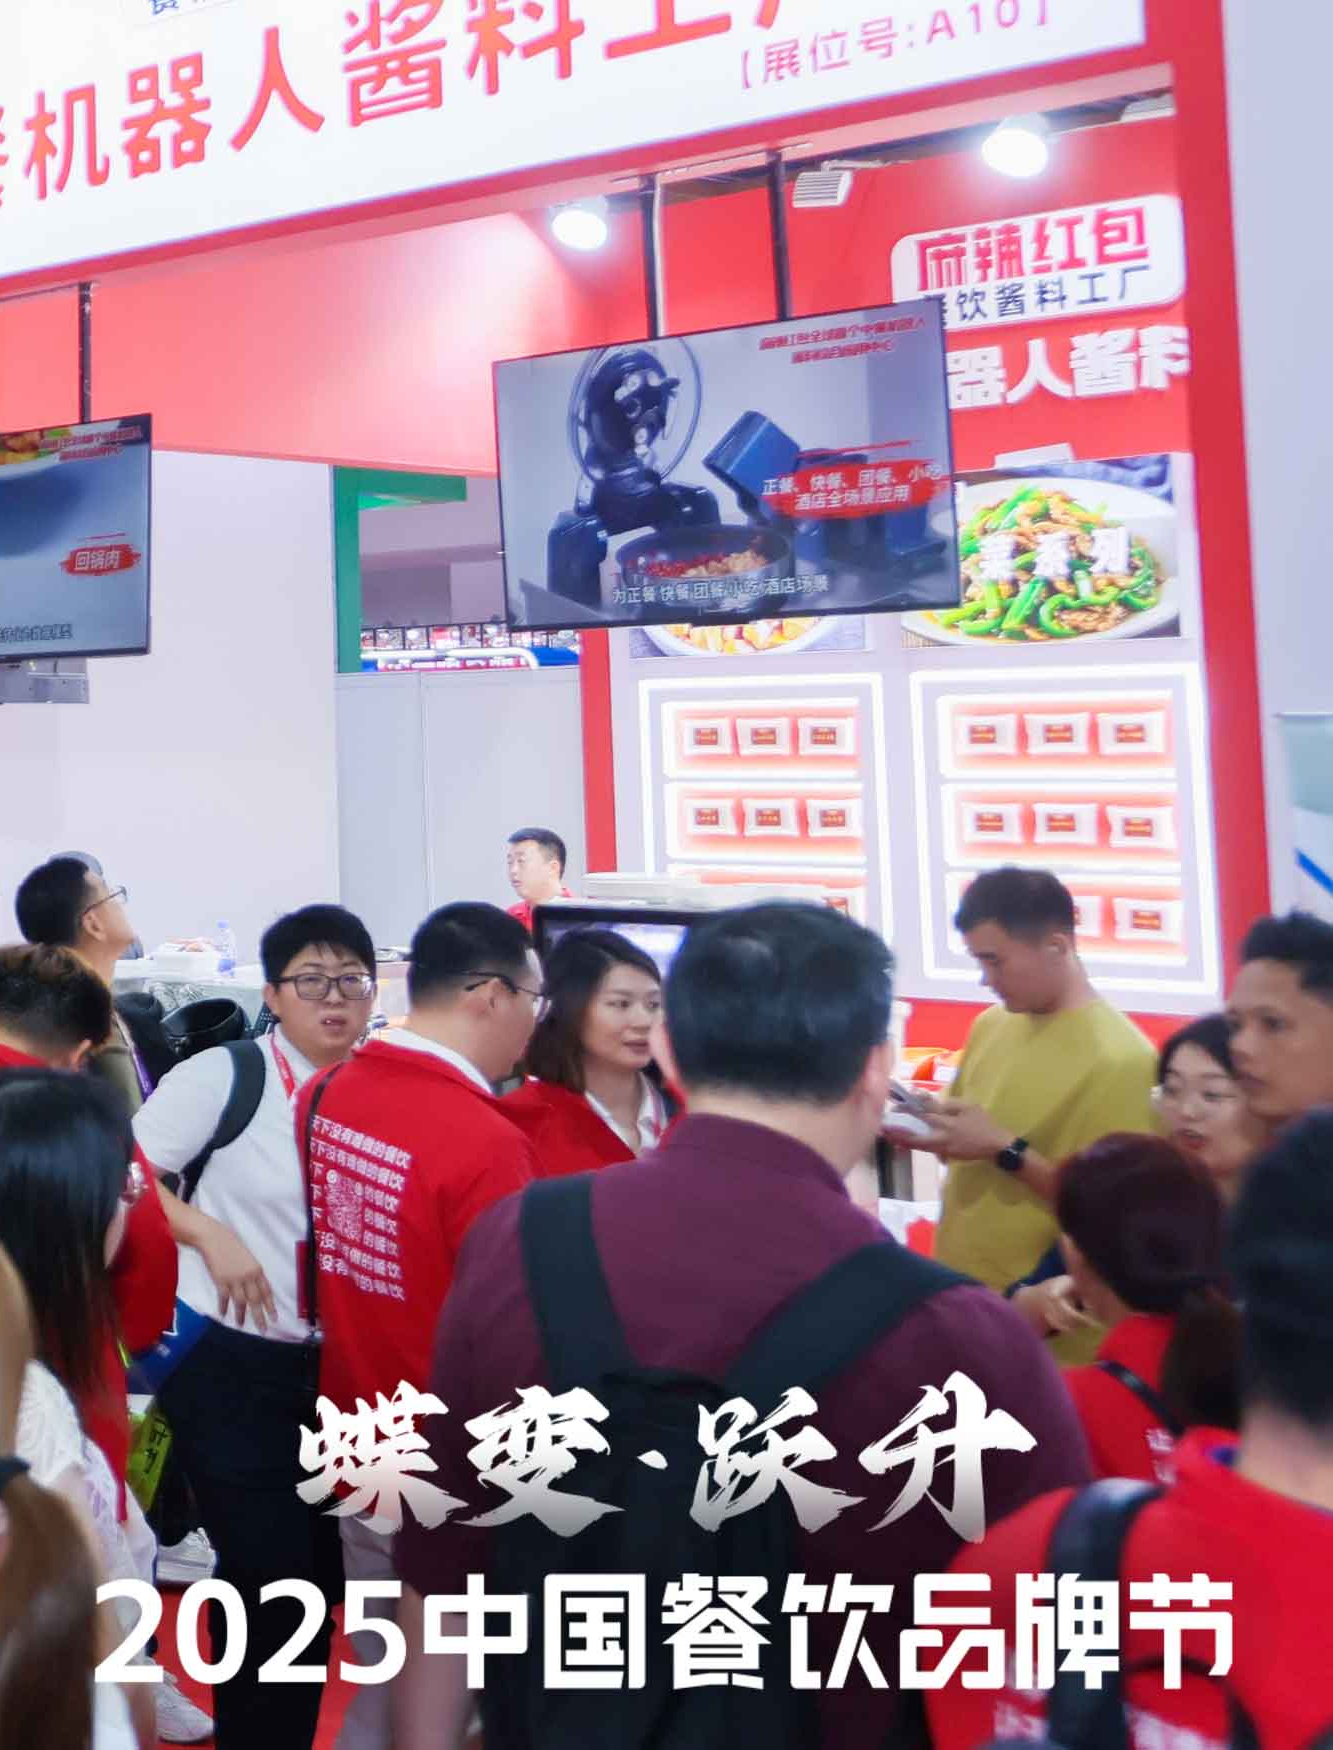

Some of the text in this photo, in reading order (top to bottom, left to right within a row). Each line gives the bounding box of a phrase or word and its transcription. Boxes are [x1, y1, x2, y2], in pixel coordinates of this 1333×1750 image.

[917, 206, 1149, 292] 麻辣红包
[925, 264, 1150, 328] 饮酱料工厂
[794, 485, 910, 511] 酒店全场景应用
[74, 550, 121, 571] 回锅肉
